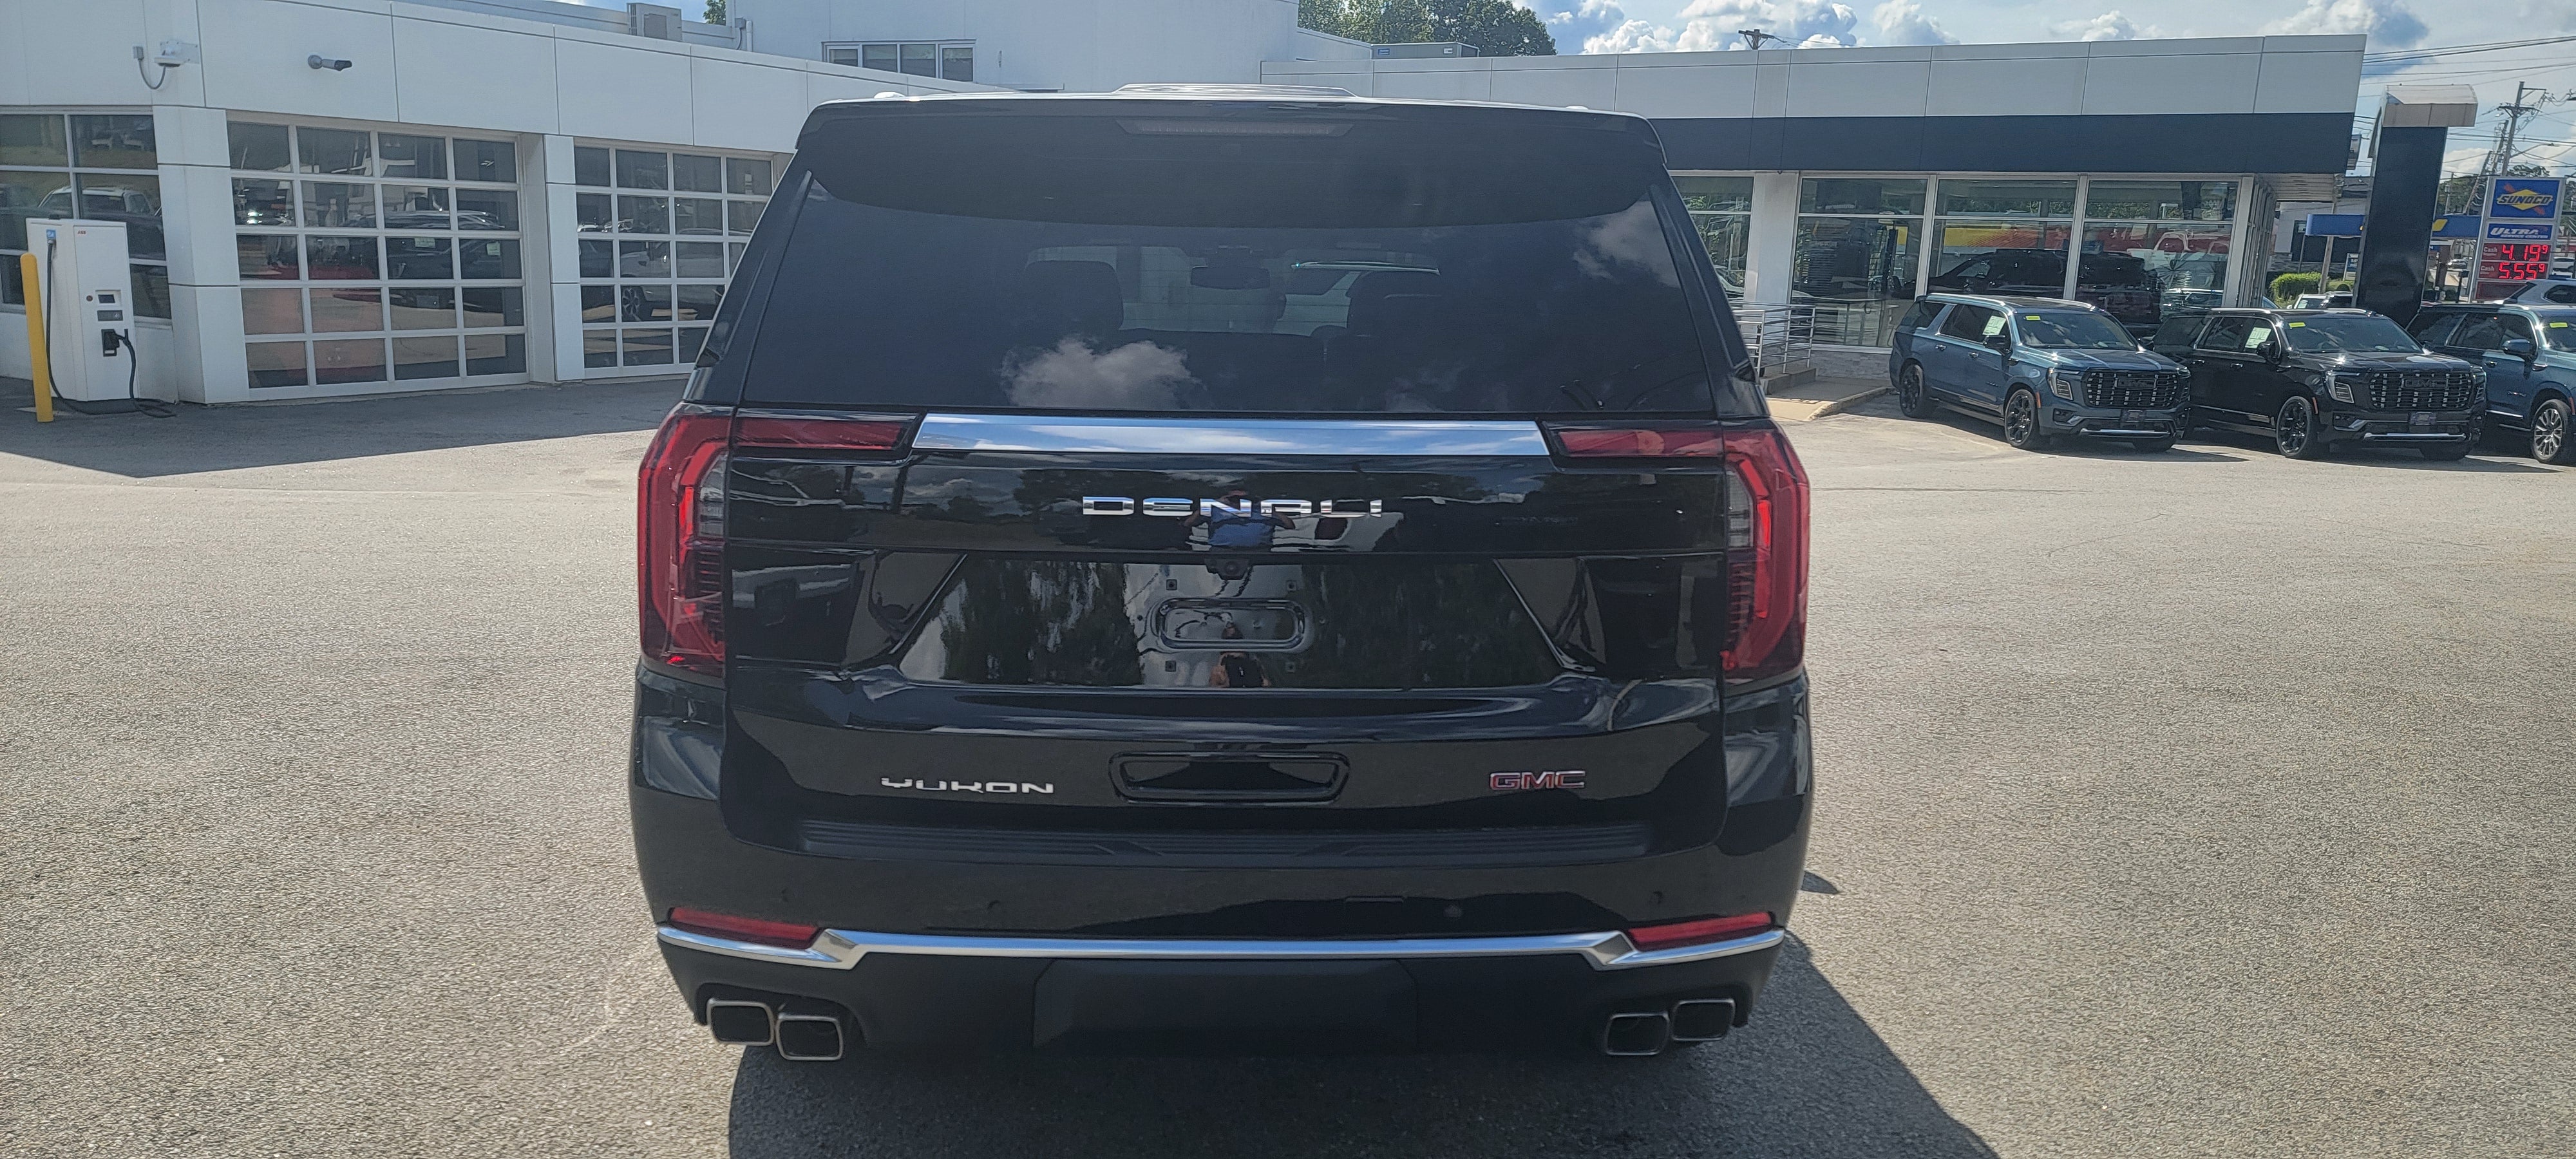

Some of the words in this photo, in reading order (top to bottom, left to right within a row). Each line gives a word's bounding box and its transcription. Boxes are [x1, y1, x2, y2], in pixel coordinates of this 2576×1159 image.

[2498, 195, 2552, 204] SUNOCO
[1083, 496, 1382, 518] DENALI
[881, 777, 1054, 794] YUKON
[1490, 770, 1586, 790] GMC
